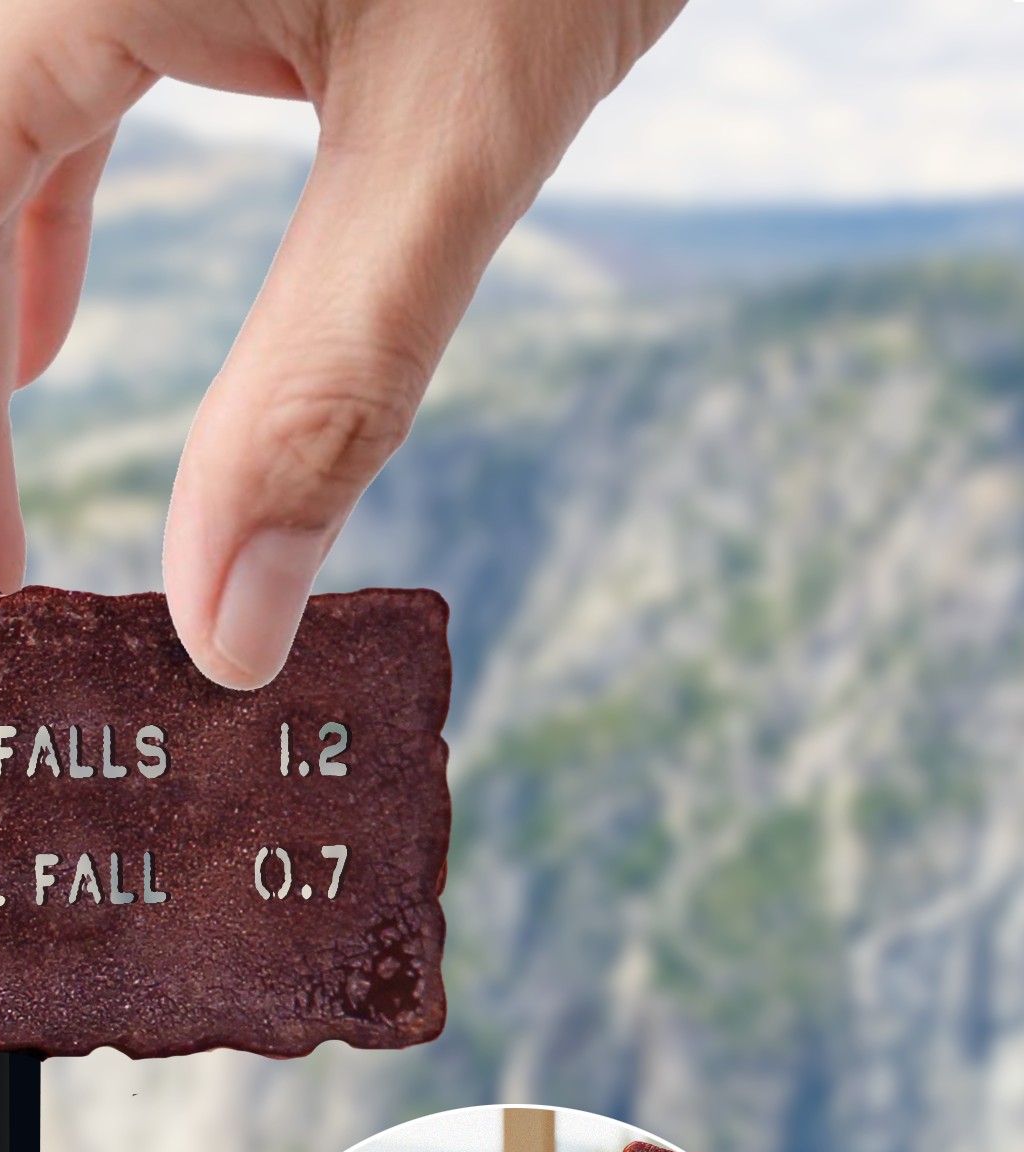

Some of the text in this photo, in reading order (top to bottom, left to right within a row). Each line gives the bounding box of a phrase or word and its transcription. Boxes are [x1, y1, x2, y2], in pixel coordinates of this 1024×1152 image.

[279, 721, 349, 778] 1.2
[34, 850, 168, 906] FALL
[254, 844, 348, 901] 0.7
